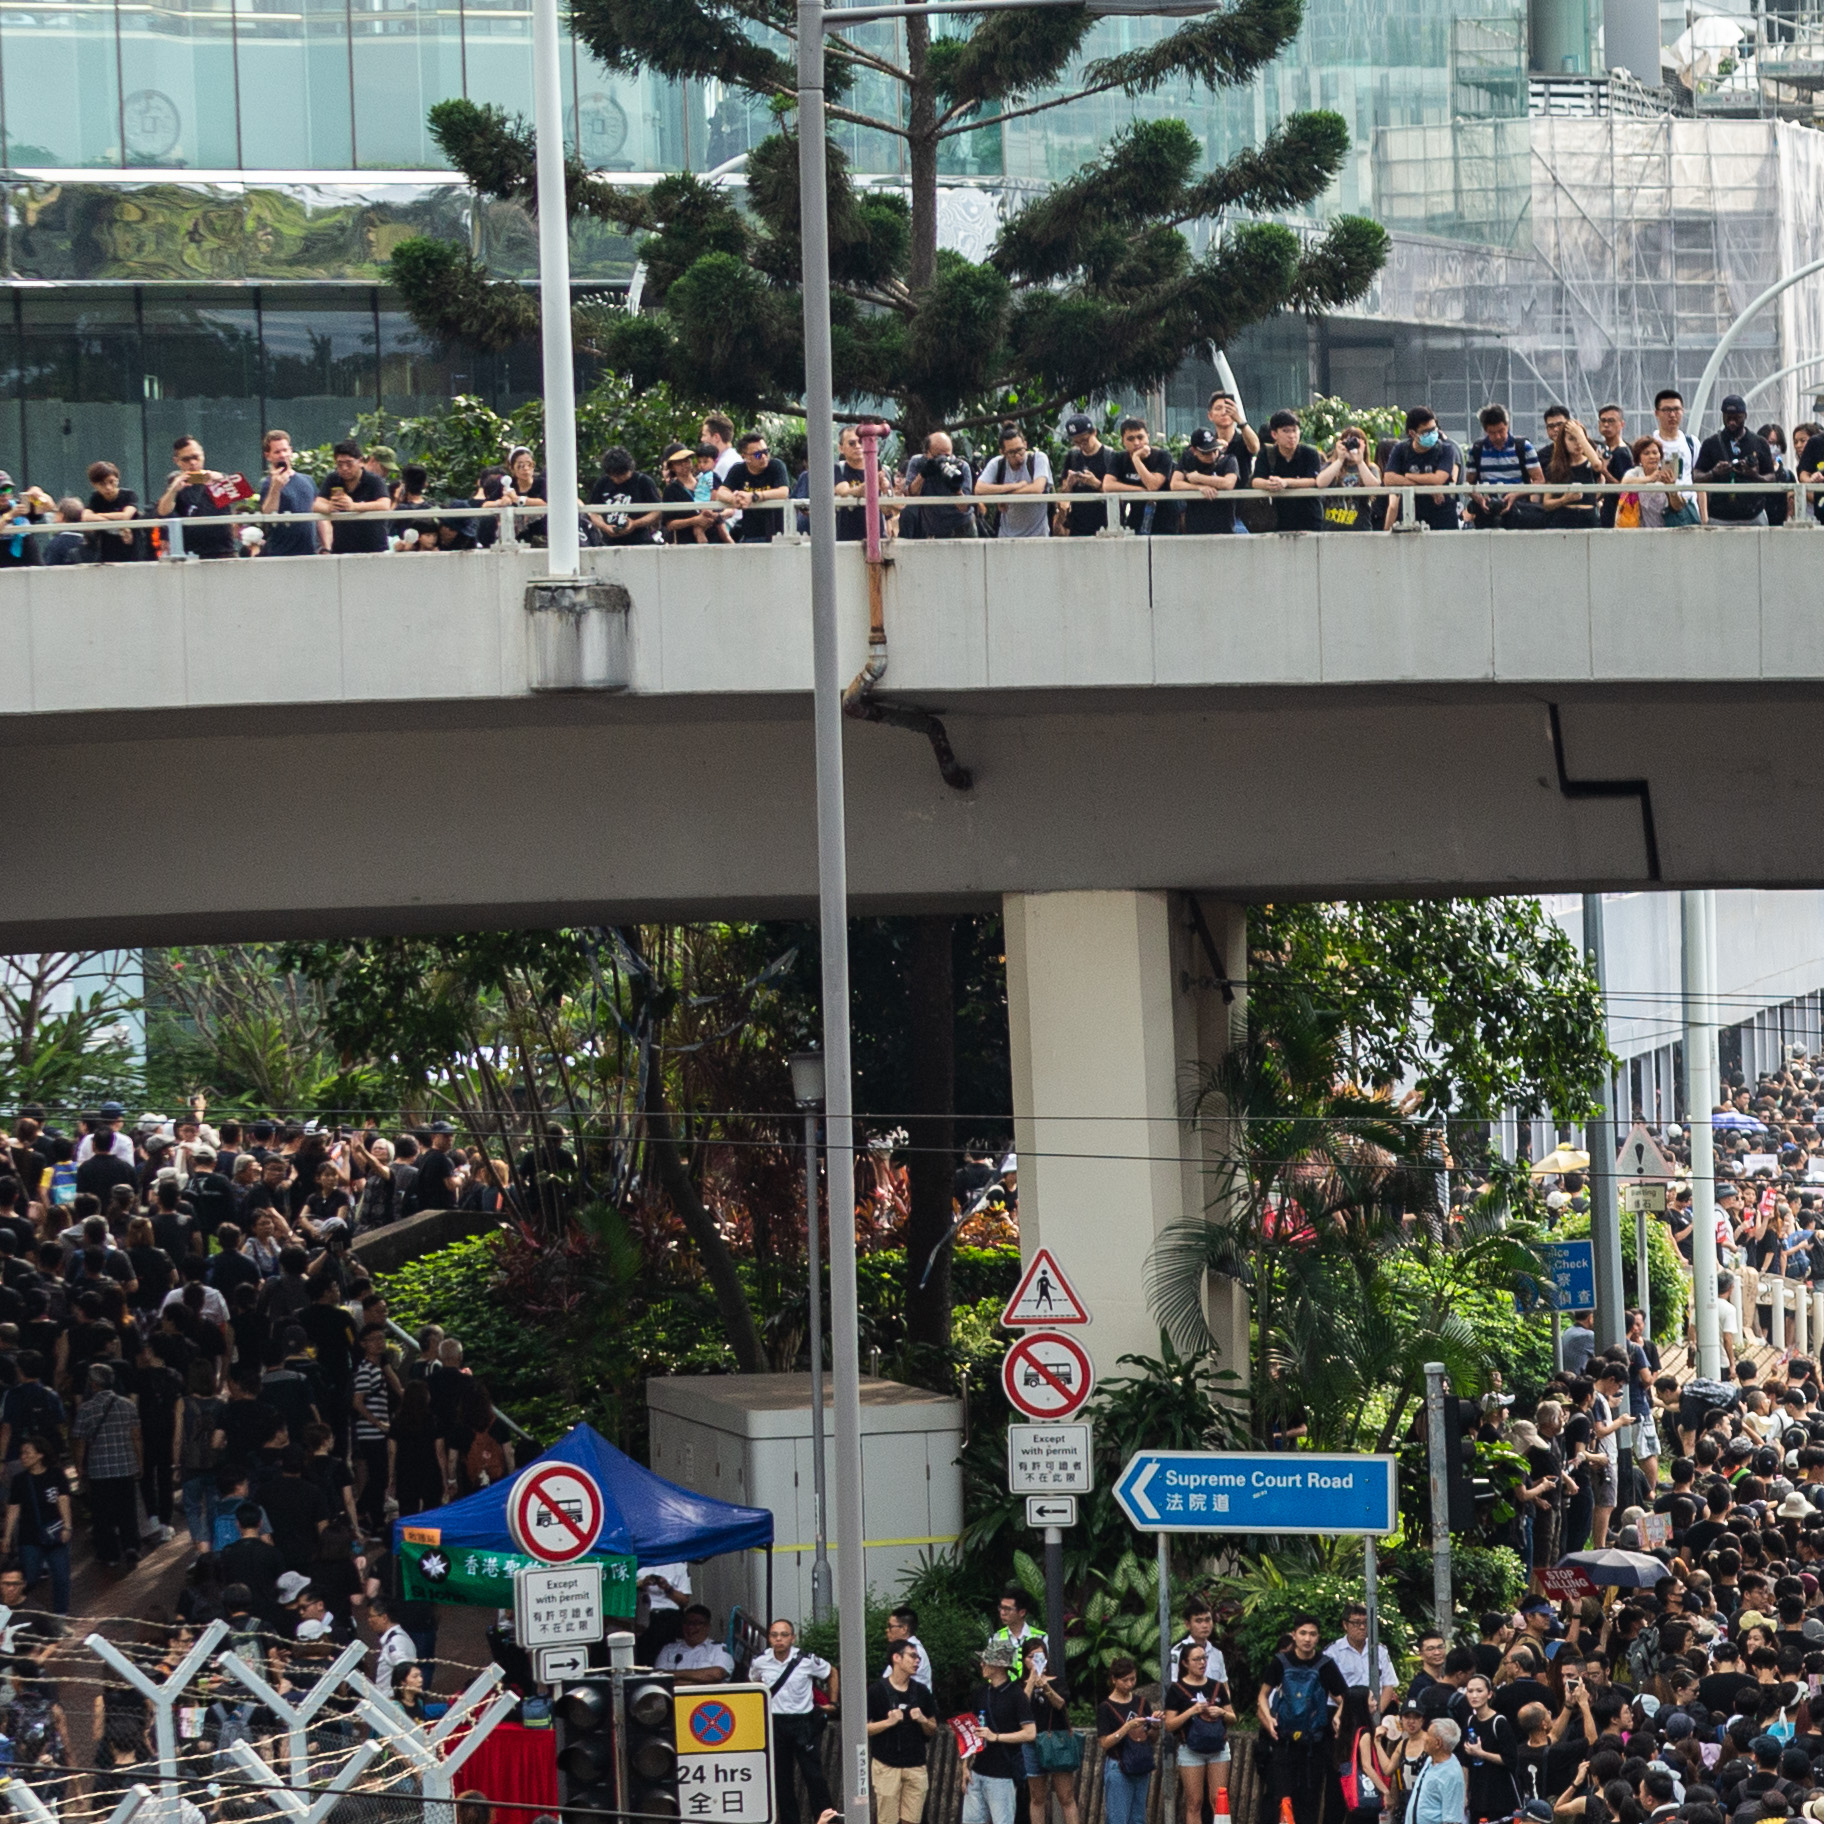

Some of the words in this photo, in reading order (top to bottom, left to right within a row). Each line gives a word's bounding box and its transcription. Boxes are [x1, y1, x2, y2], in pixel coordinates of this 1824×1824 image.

[1034, 1434, 1065, 1446] Except
[1021, 1446, 1043, 1456] with
[1046, 1446, 1078, 1458] permit
[1019, 1460, 1081, 1471] 有許可證者
[1026, 1473, 1076, 1483] 不在此限
[1165, 1468, 1246, 1488] Supreme
[1251, 1470, 1302, 1487] Court
[1307, 1471, 1355, 1489] Road
[1165, 1492, 1230, 1513] 法院道
[1545, 1569, 1574, 1583] STOP
[546, 1579, 578, 1592] Except
[1546, 1578, 1588, 1591] KILLING
[535, 1595, 564, 1606] with
[567, 1591, 590, 1606] permit
[1563, 1589, 1582, 1599] US
[532, 1607, 595, 1623] 有許可證者
[539, 1621, 588, 1634] 不在此限
[678, 1764, 707, 1785] 24
[715, 1763, 753, 1784] hrs
[688, 1791, 745, 1815] 全日
